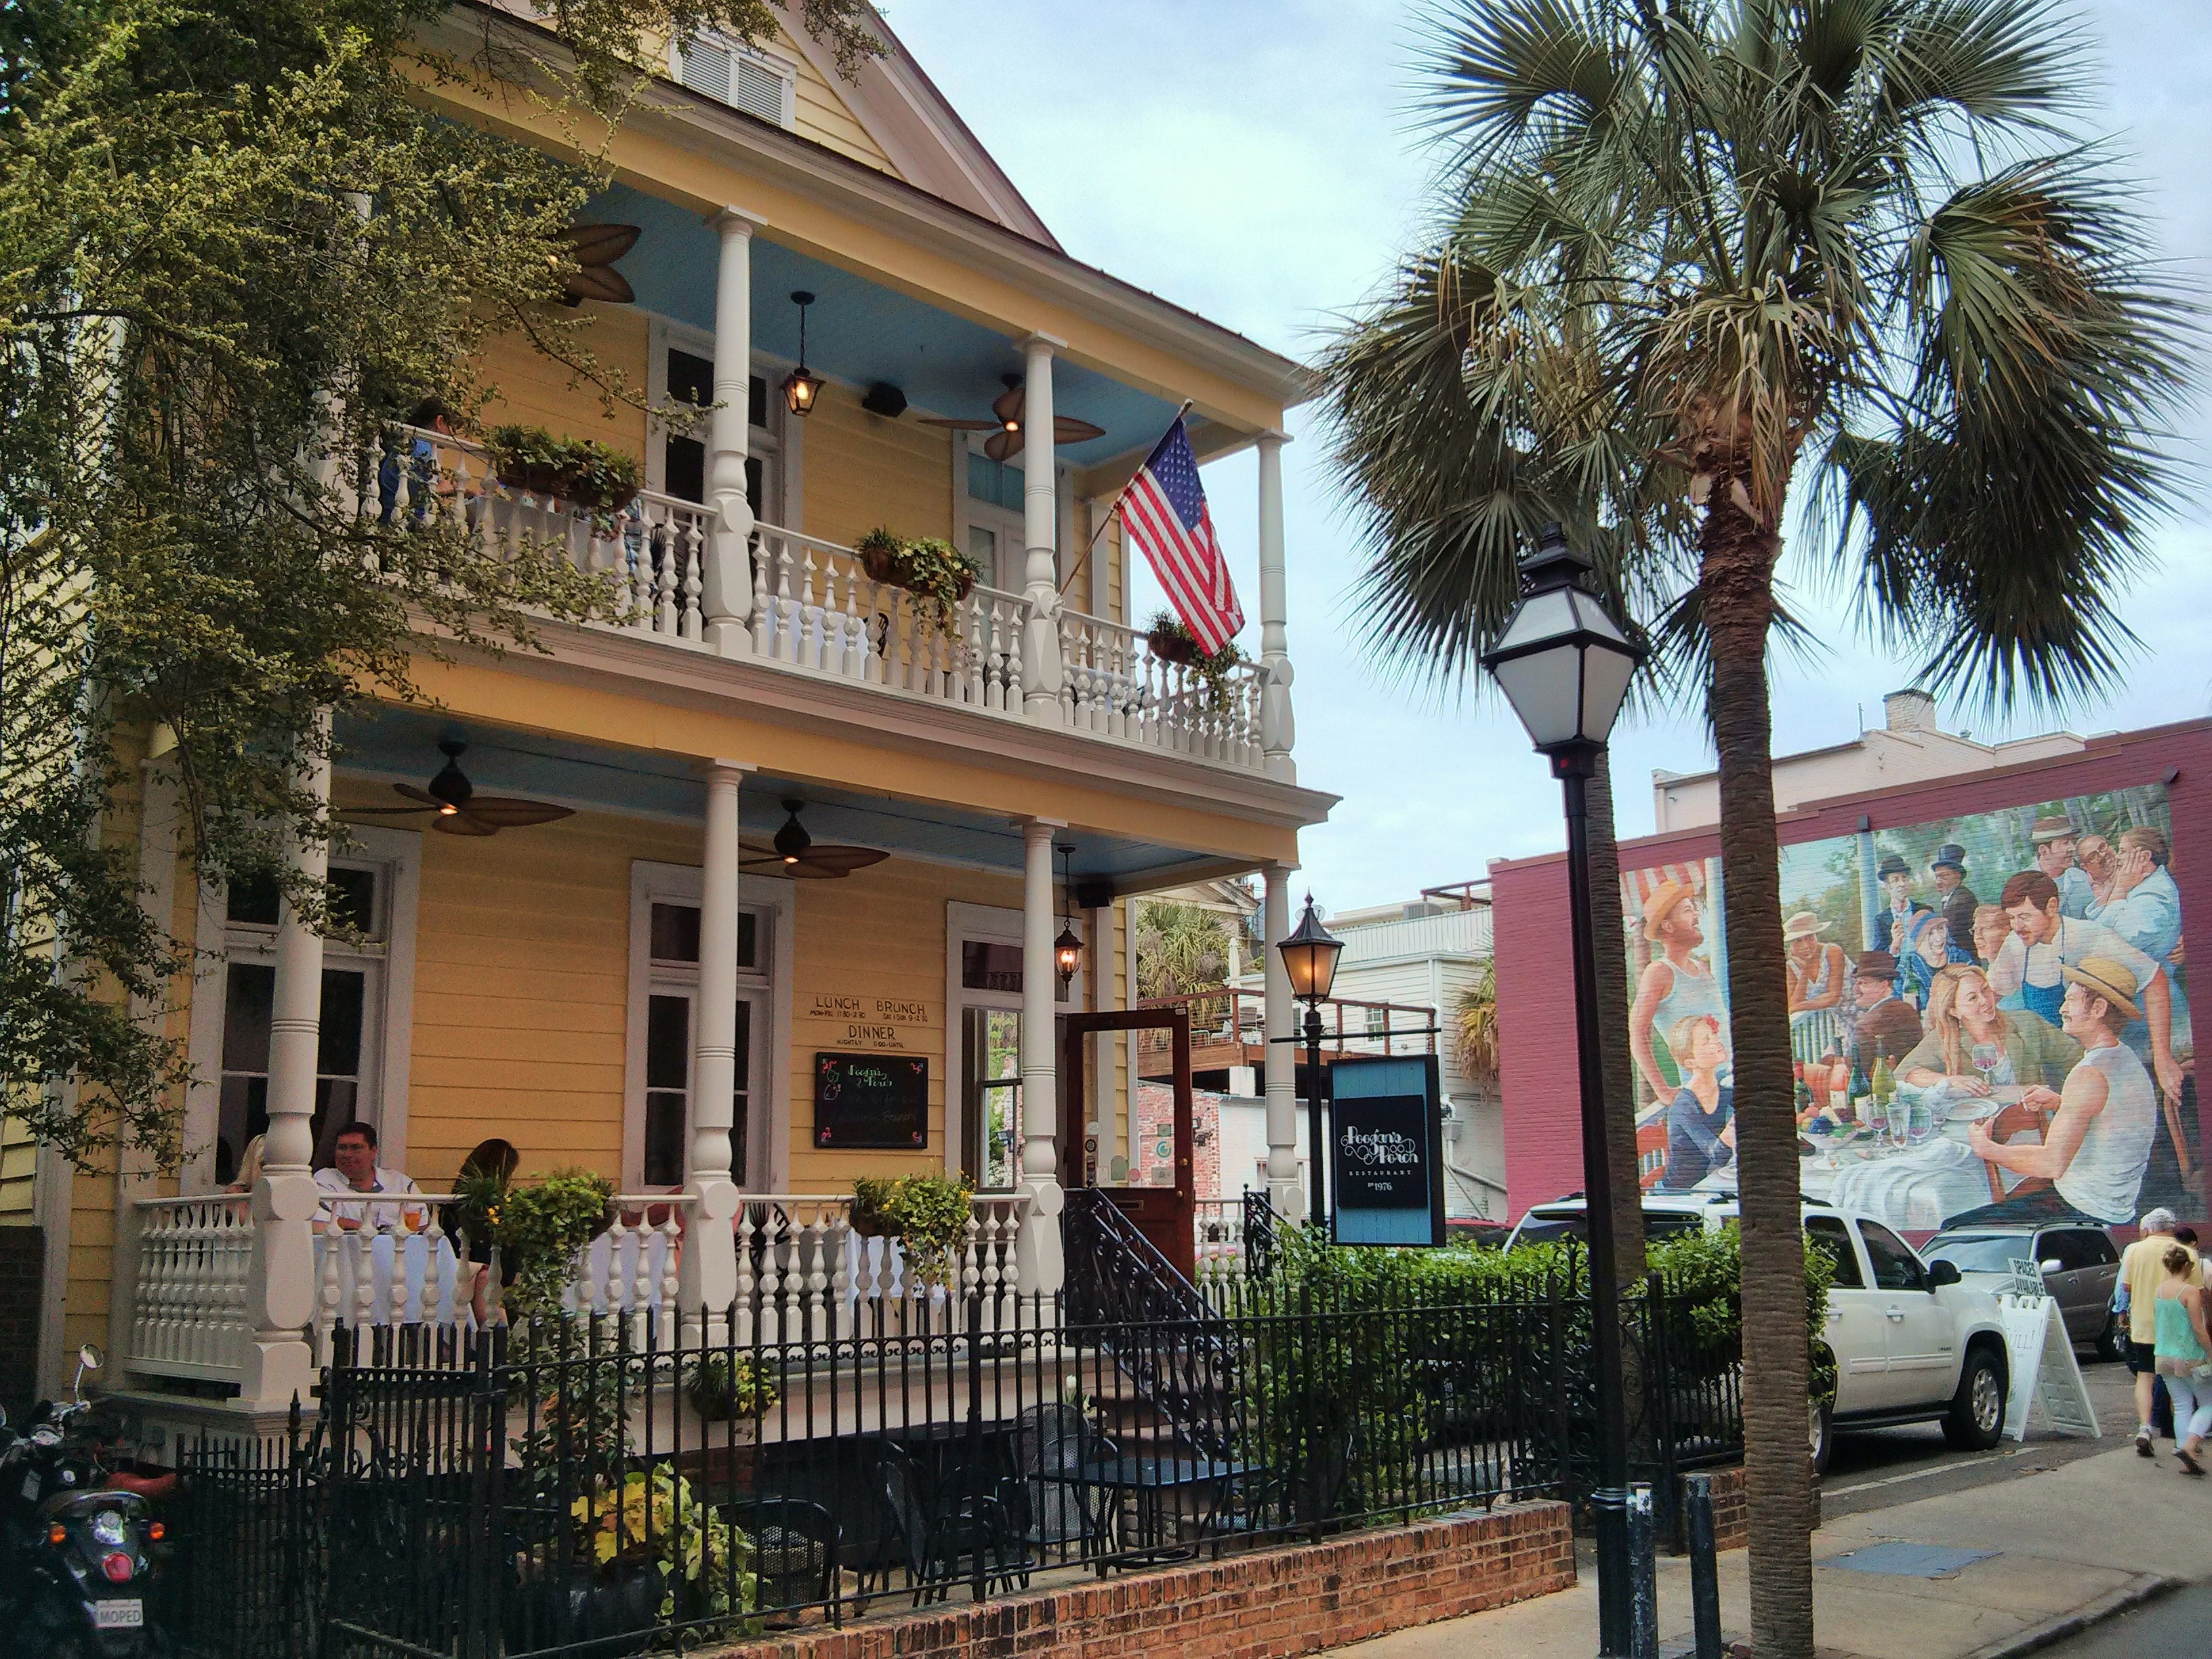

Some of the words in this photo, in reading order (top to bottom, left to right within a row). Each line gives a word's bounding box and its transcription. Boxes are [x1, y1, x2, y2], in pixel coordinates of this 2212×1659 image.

[816, 996, 859, 1010] LUNCH
[876, 1000, 925, 1015] BRUNCH
[848, 1025, 897, 1040] DINNER
[1340, 1126, 1416, 1155] Poogan's
[1374, 1182, 1393, 1191] 1976
[2013, 1259, 2036, 1278] SPACES
[100, 1610, 142, 1623] MOPED
